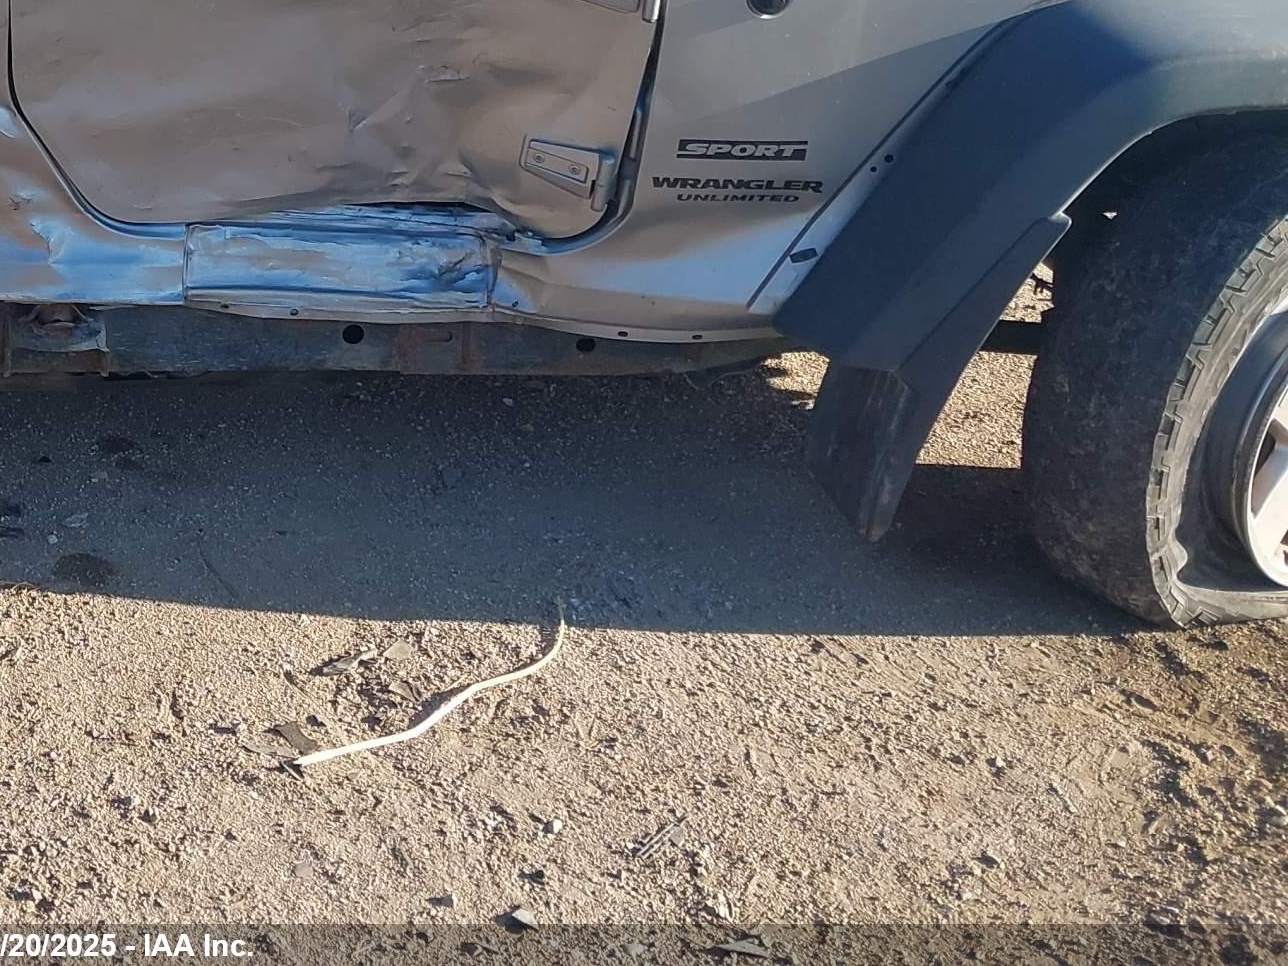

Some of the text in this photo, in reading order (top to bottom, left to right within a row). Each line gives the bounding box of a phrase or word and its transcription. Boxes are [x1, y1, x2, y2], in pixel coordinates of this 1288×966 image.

[684, 143, 808, 157] SPORT
[652, 176, 824, 193] WRANGLER
[677, 193, 800, 203] UNLIMITED
